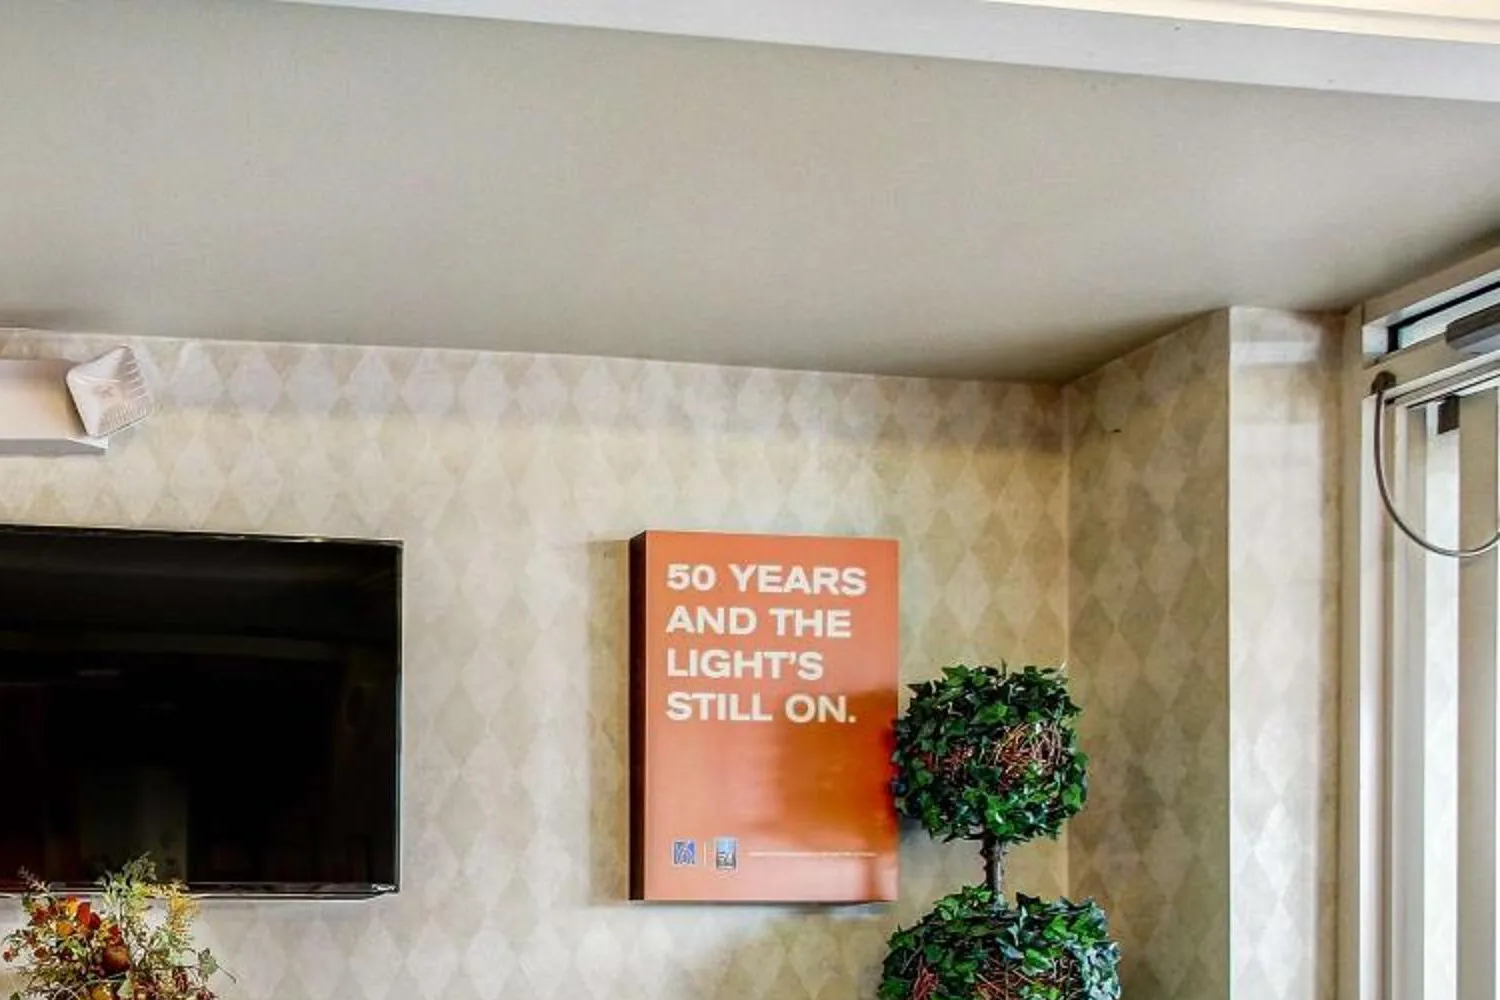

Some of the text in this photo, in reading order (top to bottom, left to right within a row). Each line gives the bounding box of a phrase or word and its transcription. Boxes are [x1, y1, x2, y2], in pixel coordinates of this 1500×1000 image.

[666, 563, 868, 597] 50 YEARS
[665, 605, 852, 639] AND THE
[667, 648, 824, 681] LIGHT'S
[665, 690, 857, 724] STILL ON.
